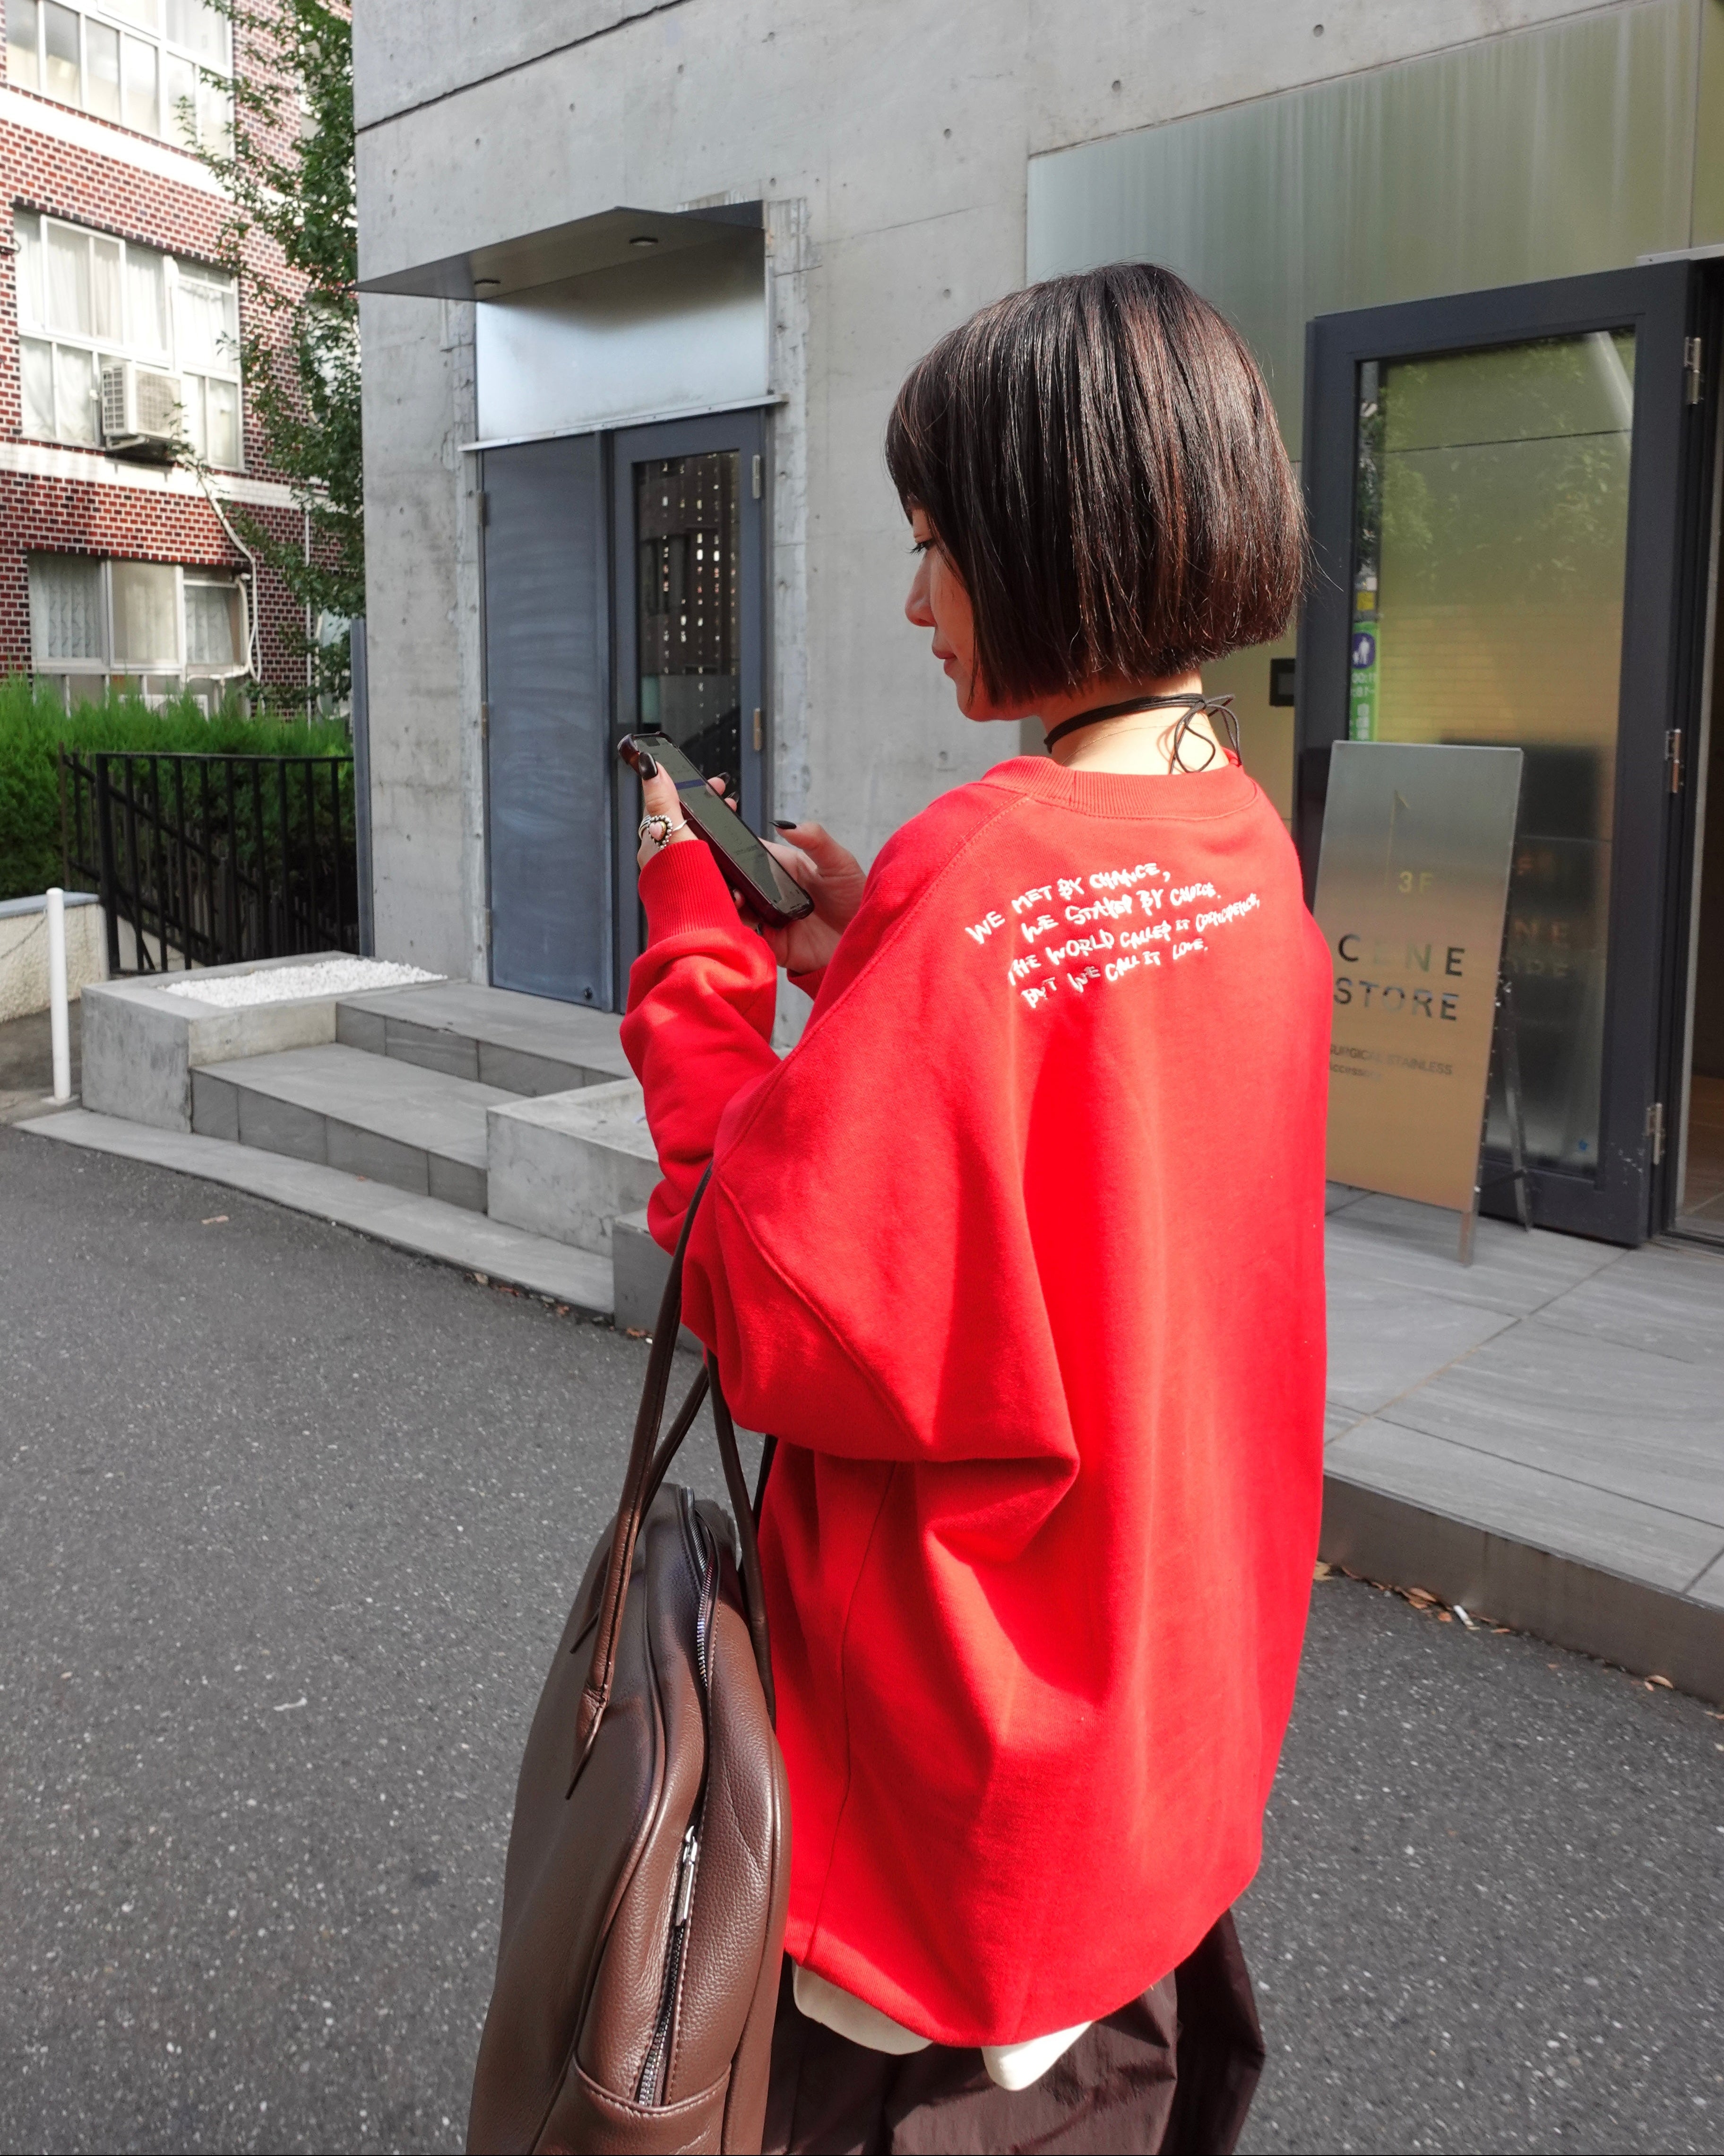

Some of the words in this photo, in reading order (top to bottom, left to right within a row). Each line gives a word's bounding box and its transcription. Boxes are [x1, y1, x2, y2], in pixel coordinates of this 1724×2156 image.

[965, 911, 1005, 944] WE
[1011, 885, 1052, 914] MET
[1057, 877, 1085, 900] BY
[1089, 862, 1171, 890] CHANCE,
[1398, 871, 1434, 894] 3F
[1021, 914, 1059, 944] WE
[1065, 893, 1132, 925] STAYED
[1136, 889, 1164, 916] BY
[1170, 882, 1221, 907] CHOICE.
[1045, 928, 1114, 966] WORLD
[1120, 919, 1172, 949] CALLED
[1175, 919, 1190, 932] IT
[1021, 977, 1057, 1009] BUT
[1067, 966, 1101, 993] WE
[1105, 955, 1140, 982] CALL
[1142, 951, 1161, 966] IT
[1172, 938, 1208, 960] LOVE.
[1333, 976, 1459, 1021] STORE
